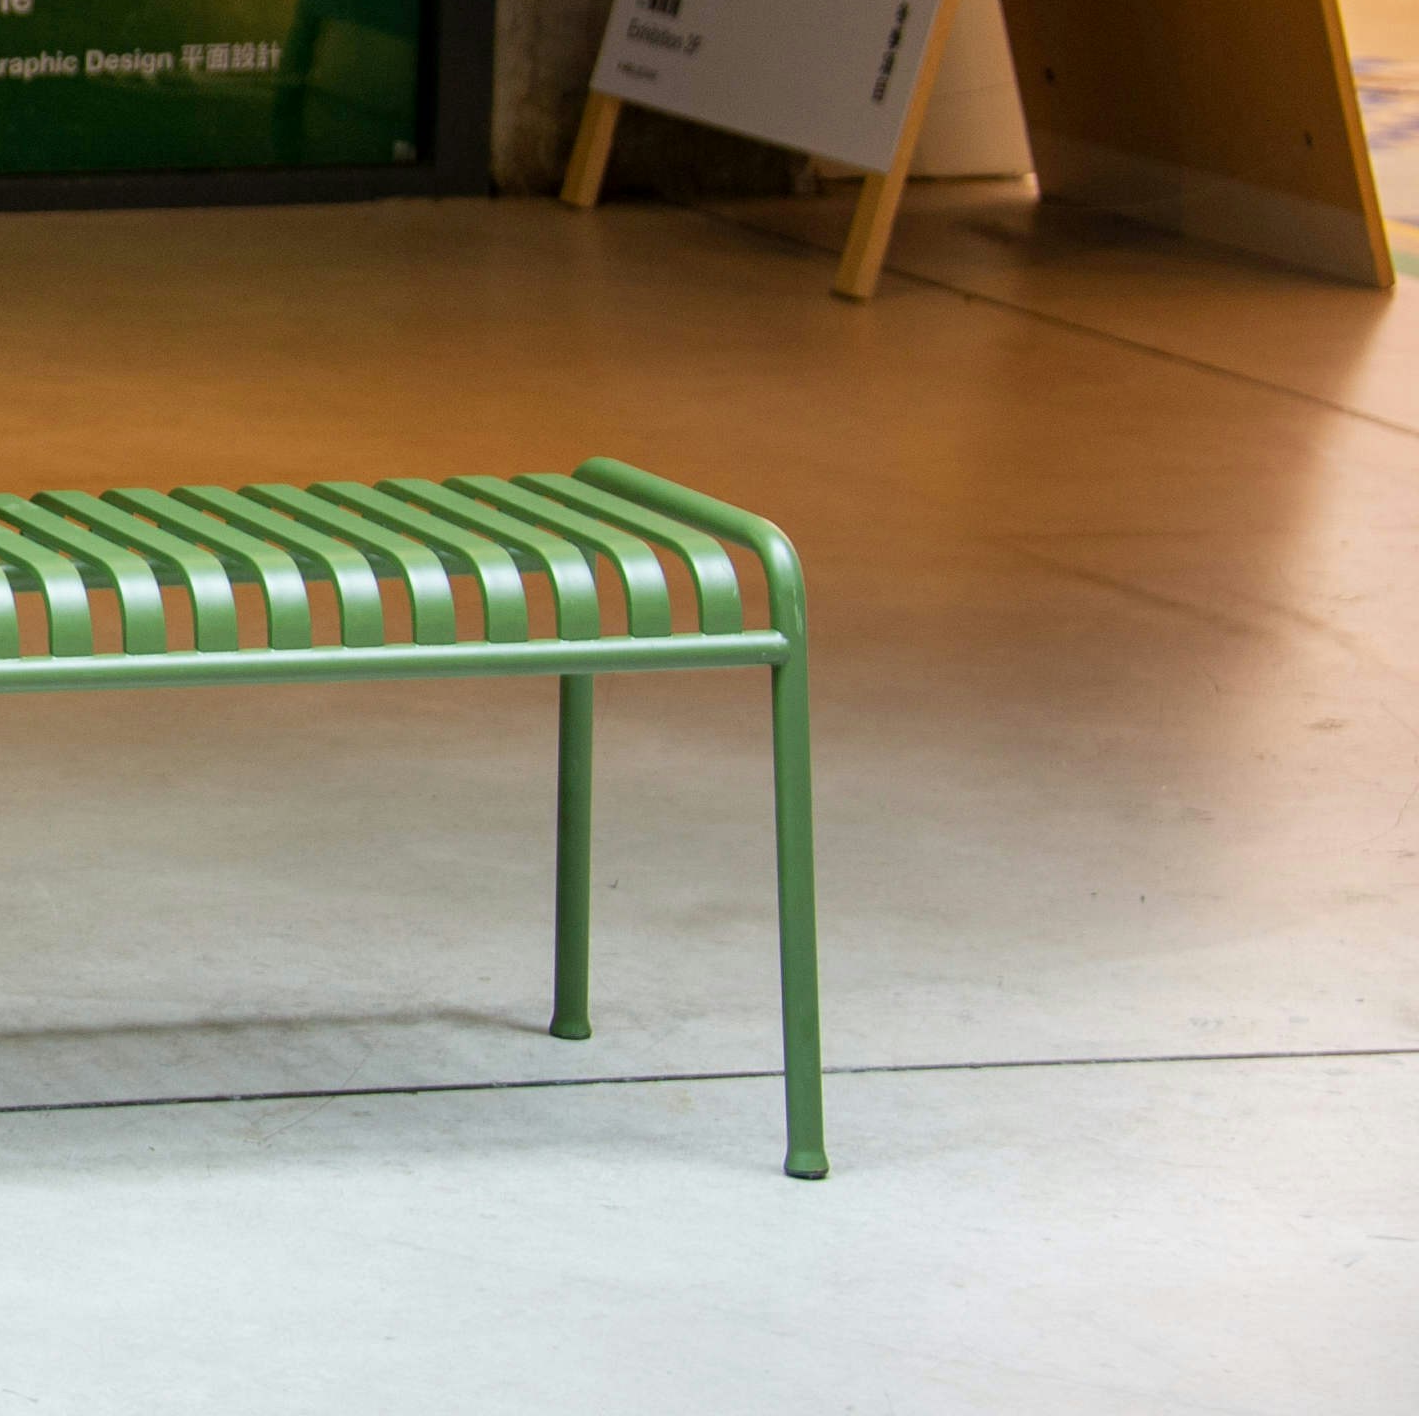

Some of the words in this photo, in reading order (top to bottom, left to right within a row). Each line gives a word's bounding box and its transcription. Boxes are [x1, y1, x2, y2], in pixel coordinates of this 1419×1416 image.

[85, 46, 173, 76] Design
[180, 41, 282, 74] 平面設計
